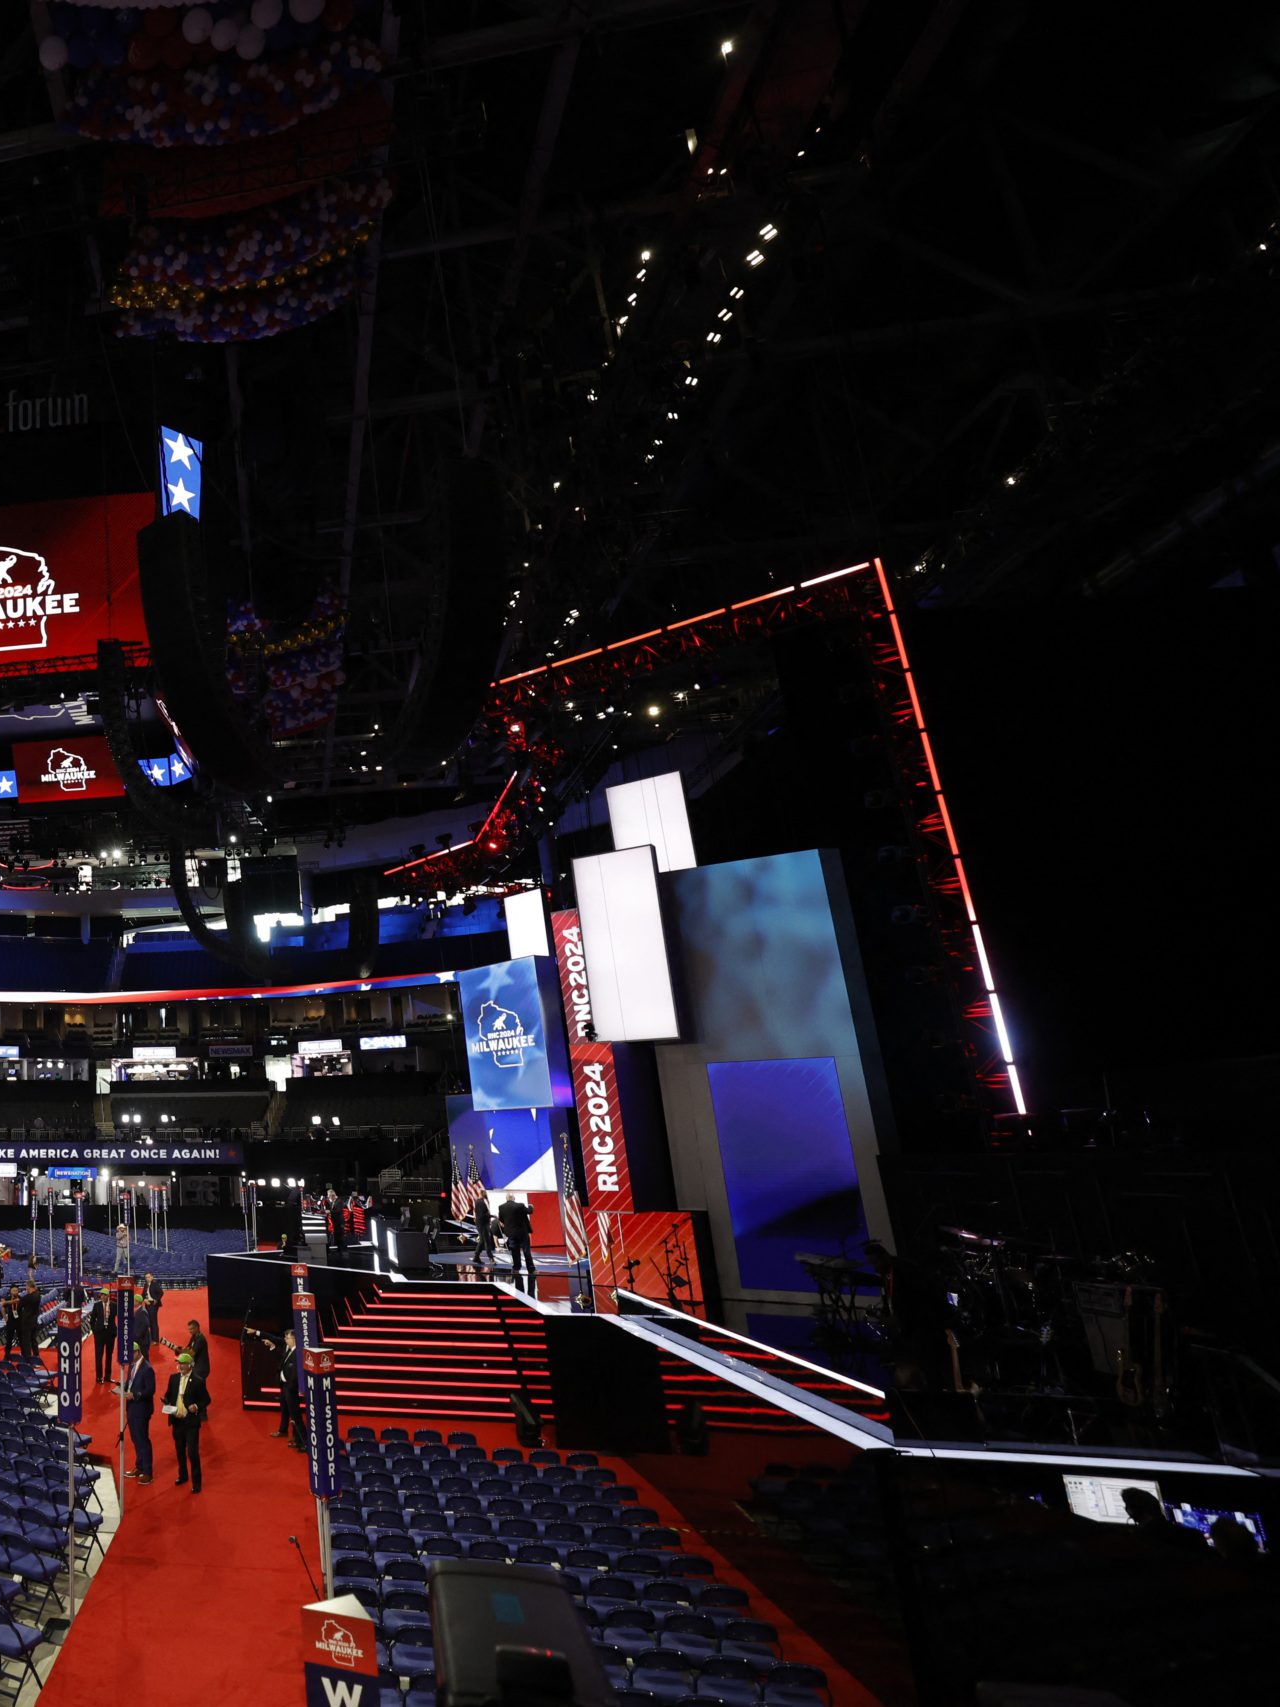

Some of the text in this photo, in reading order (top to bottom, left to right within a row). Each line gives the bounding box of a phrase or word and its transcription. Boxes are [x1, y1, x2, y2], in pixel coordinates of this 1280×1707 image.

[41, 770, 96, 782] MILWAUKEE
[562, 926, 588, 987] 2024
[210, 1047, 251, 1055] NEWSMAX
[471, 1035, 535, 1053] MILWAUKEE
[20, 1149, 79, 1159] AMERICA
[83, 1149, 125, 1159] GREAT
[130, 1149, 167, 1159] ONCE
[172, 1149, 220, 1159] AGAIN!
[586, 1063, 620, 1192] RNC 2024
[60, 1341, 70, 1407] OHIO
[73, 1341, 81, 1407] OHIO
[307, 1375, 318, 1489] MISSOURI
[322, 1376, 335, 1490] MISSOURI
[315, 1640, 363, 1658] MILWAUKEE
